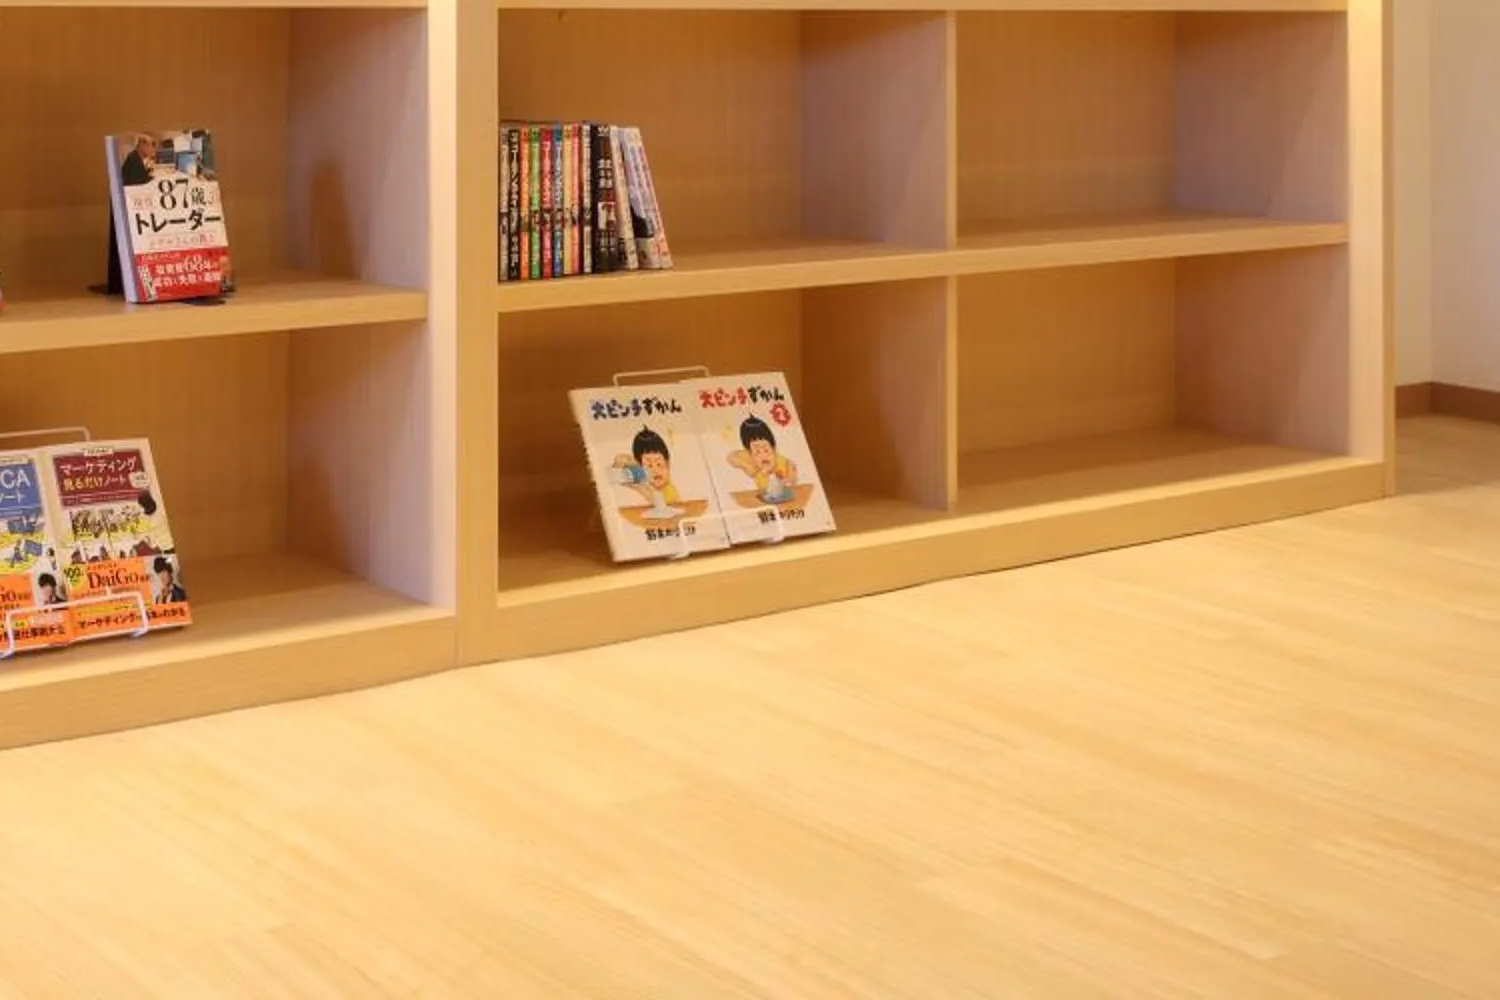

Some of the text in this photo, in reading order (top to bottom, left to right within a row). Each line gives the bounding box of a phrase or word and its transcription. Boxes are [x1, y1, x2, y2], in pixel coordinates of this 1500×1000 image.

[135, 207, 221, 236] トレーダー
[699, 384, 785, 409] 大ピンチずかん
[590, 396, 683, 420] 大ピンチずかん
[59, 455, 138, 475] マーケティング
[62, 475, 127, 492] 見るだけノート
[87, 569, 137, 589] DaiGo
